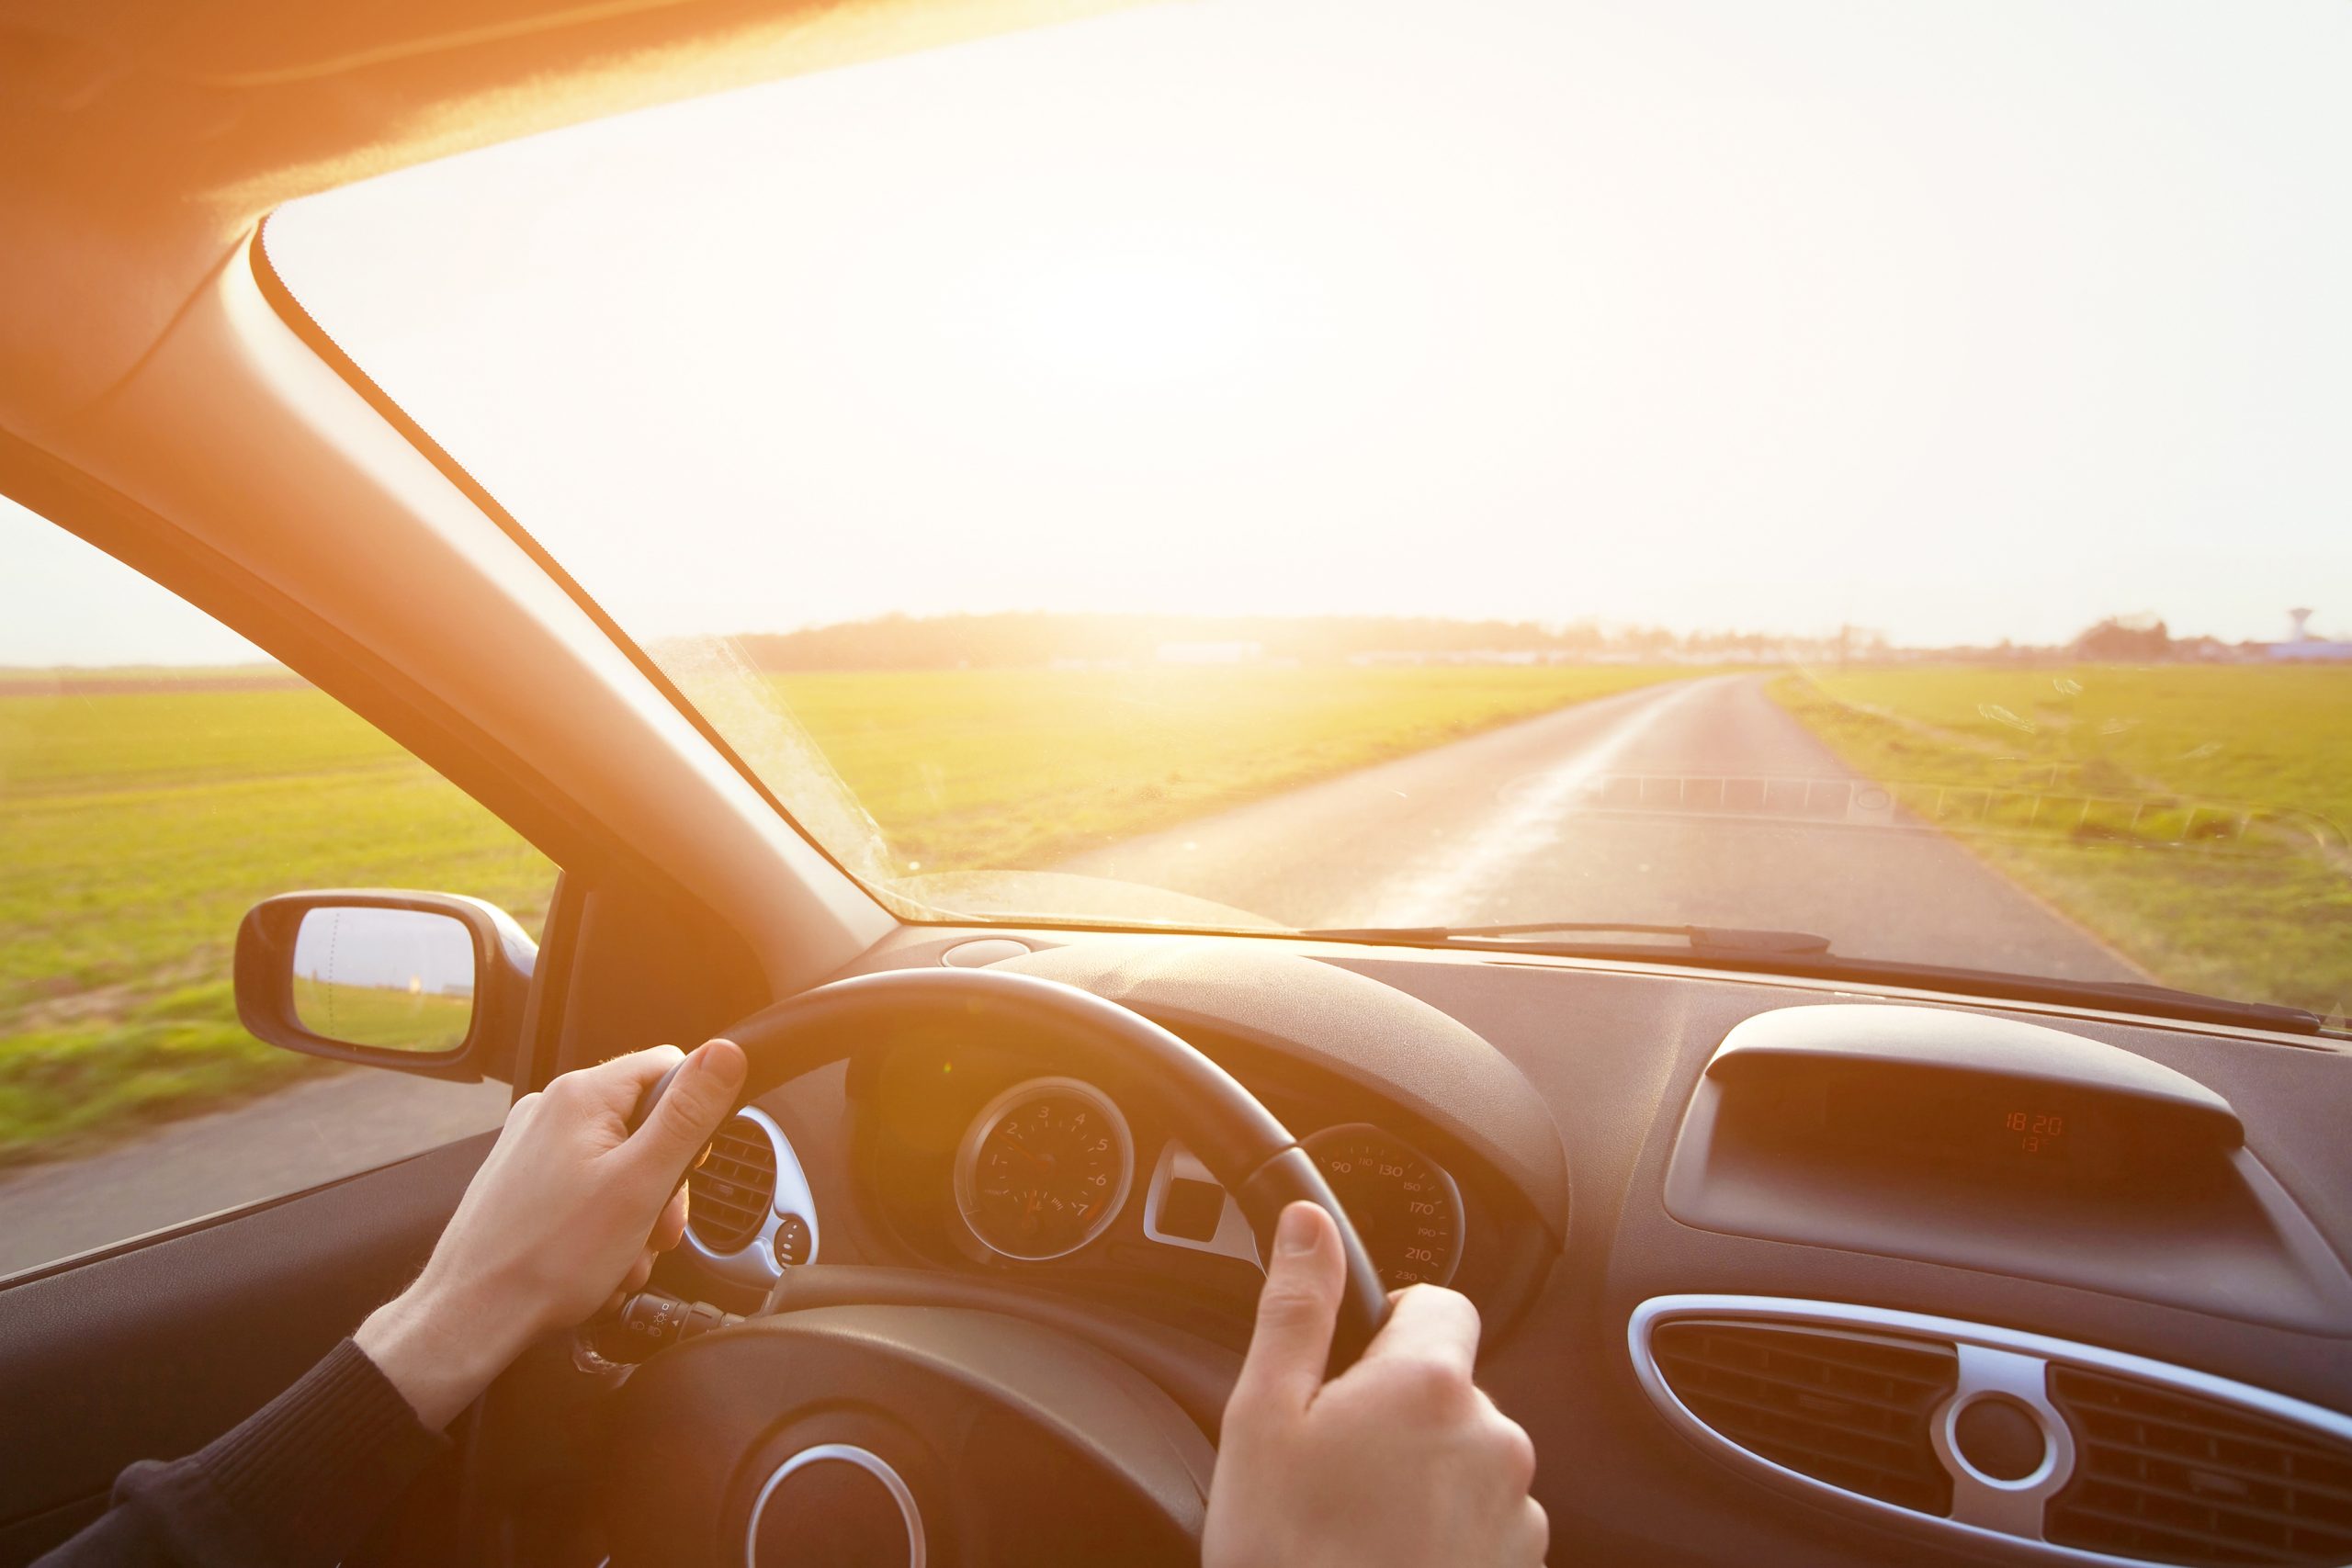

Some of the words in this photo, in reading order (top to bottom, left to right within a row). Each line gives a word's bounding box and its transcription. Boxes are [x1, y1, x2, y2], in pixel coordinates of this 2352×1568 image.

[1038, 1106, 1050, 1118] 3
[1075, 1113, 1086, 1124] 4
[1007, 1122, 1018, 1134] 2
[1096, 1139, 1108, 1151] 5
[991, 1154, 998, 1166] 1
[1358, 1157, 1374, 1167] 110
[1331, 1161, 1351, 1173] 90
[1378, 1164, 1404, 1178] 130
[1095, 1174, 1107, 1186] 6
[1403, 1181, 1421, 1192] 150
[1077, 1203, 1090, 1216] 7
[1409, 1201, 1434, 1215] 170
[1418, 1227, 1436, 1237] 190
[1405, 1247, 1431, 1262] 210
[1396, 1269, 1418, 1281] 230
